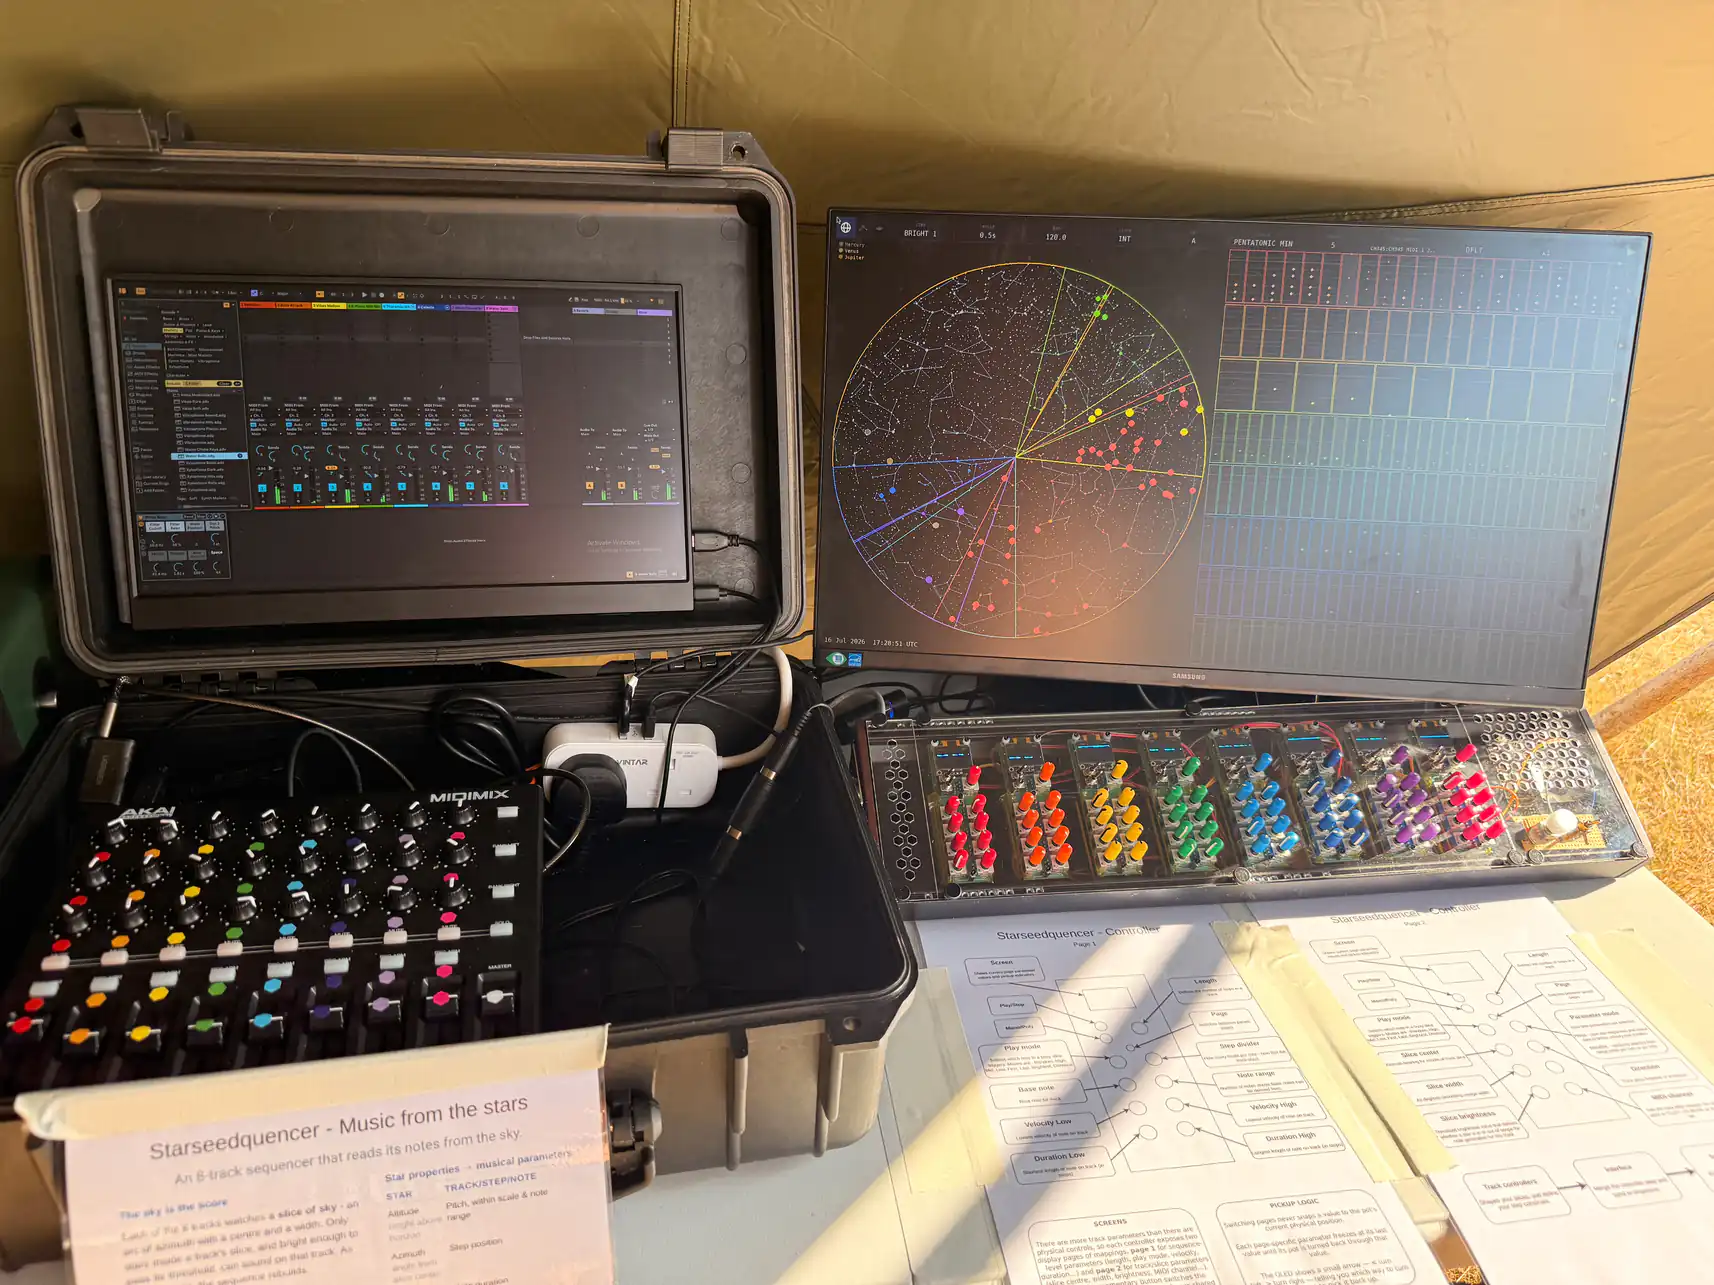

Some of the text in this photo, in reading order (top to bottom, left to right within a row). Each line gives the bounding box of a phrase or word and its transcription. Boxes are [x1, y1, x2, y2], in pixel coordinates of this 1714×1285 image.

[903, 229, 929, 237] BRIGHT
[979, 231, 997, 239] 0.5s
[1045, 233, 1067, 241] 120.0
[1118, 235, 1131, 243] INT
[1233, 238, 1277, 247] PENTATONIC
[824, 636, 833, 644] 16
[836, 637, 847, 645] Jul
[850, 637, 866, 645] 2026
[1172, 672, 1206, 681] SAMSUNG
[429, 789, 510, 803] MIDIMIX
[119, 806, 177, 818] AKAI
[1329, 903, 1481, 924] Starseedquencer Controller
[996, 928, 1095, 941] Starseedquencer
[1105, 924, 1161, 937] Controller
[1073, 941, 1090, 949] Page
[1193, 977, 1218, 985] Length
[1004, 1044, 1020, 1052] Play
[1219, 1040, 1260, 1050] Step divider
[1400, 1049, 1440, 1059] Slice center
[1236, 1070, 1276, 1079] Note range
[1425, 1080, 1464, 1090] Slice width
[1249, 1101, 1298, 1111] Velocity High
[1440, 1111, 1497, 1122] Slice brightness
[149, 1123, 320, 1160] Starseedquencer
[339, 1112, 395, 1135] Music
[401, 1108, 443, 1127] from
[448, 1102, 478, 1120] the
[483, 1095, 529, 1116] stars
[1024, 1119, 1054, 1128] Velocity
[1265, 1131, 1317, 1142] Duration High
[245, 1157, 314, 1176] sequencer
[318, 1151, 344, 1166] that
[347, 1146, 383, 1162] reads
[386, 1142, 401, 1155] its
[404, 1139, 440, 1154] notes
[443, 1134, 474, 1148] from
[476, 1132, 497, 1144] the
[499, 1128, 523, 1142] sky.
[1034, 1153, 1067, 1162] Duration
[385, 1150, 573, 1183] Star properties musical parameters
[386, 1172, 537, 1201] STAR TRACK/STEP/NOTE
[1502, 1178, 1538, 1188] controllers
[198, 1198, 229, 1210] score
[387, 1187, 548, 1218] Altitude Pitch, within scale & note
[1269, 1198, 1320, 1209] PICKUP LOGIC
[277, 1200, 360, 1219] slice of sky an
[446, 1211, 472, 1222] range
[1223, 1221, 1256, 1230] Switching
[1256, 1218, 1277, 1227] pages
[1296, 1214, 1316, 1223] snaps
[1093, 1218, 1128, 1228] SCREENS
[1264, 1224, 1289, 1232] current
[1289, 1219, 1317, 1230] physical
[1035, 1240, 1055, 1248] There
[1069, 1237, 1088, 1245] more
[1088, 1235, 1106, 1243] track
[1107, 1231, 1146, 1242] parameters
[1146, 1229, 1162, 1238] than
[1162, 1227, 1181, 1235] there
[1235, 1242, 1252, 1250] Each
[1253, 1237, 1297, 1249] page-specific
[1297, 1233, 1331, 1245] parameter
[1332, 1230, 1357, 1239] freezes
[390, 1237, 503, 1261] Azimuth Step position
[1037, 1246, 1064, 1257] physical
[1106, 1241, 1123, 1249] each
[1123, 1237, 1155, 1247] controller
[1156, 1235, 1185, 1244] exposes
